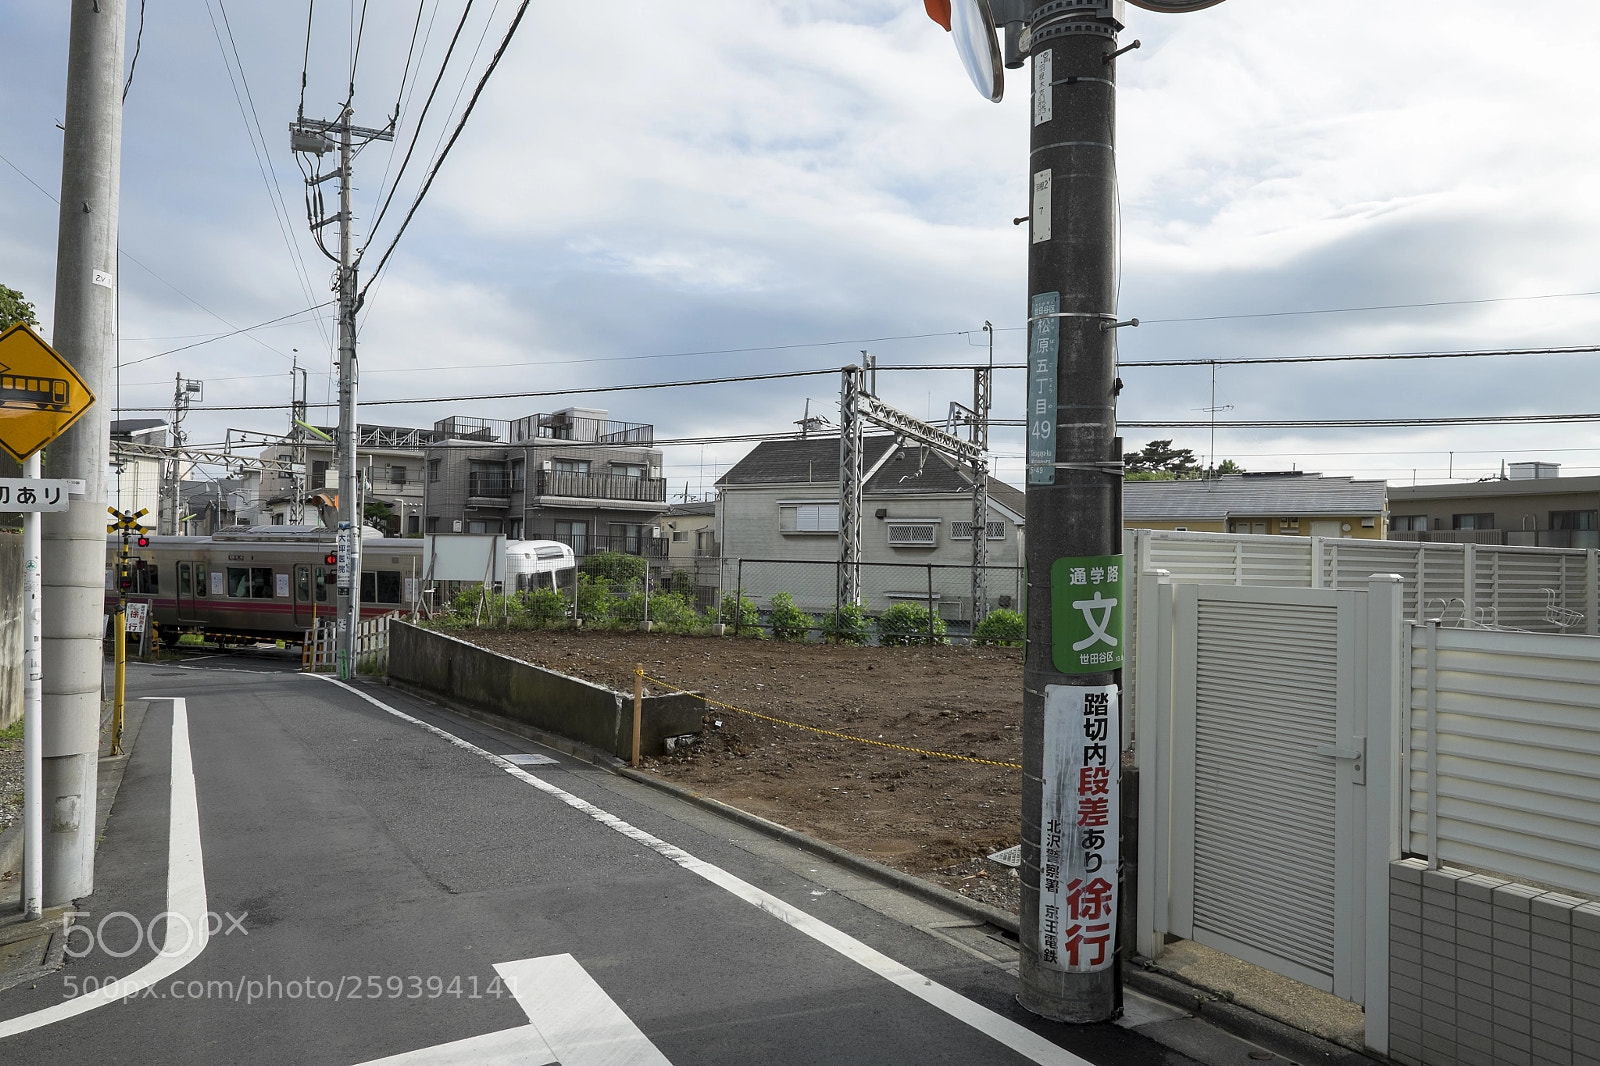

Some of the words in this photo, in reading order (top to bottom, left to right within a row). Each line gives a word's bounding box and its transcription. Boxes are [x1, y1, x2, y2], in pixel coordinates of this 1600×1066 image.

[1036, 318, 1050, 414] 松原五丁目
[1031, 421, 1051, 439] 49
[1069, 566, 1119, 585] 通学路
[1080, 651, 1113, 665] 世田谷区
[1065, 877, 1113, 966] 徐行
